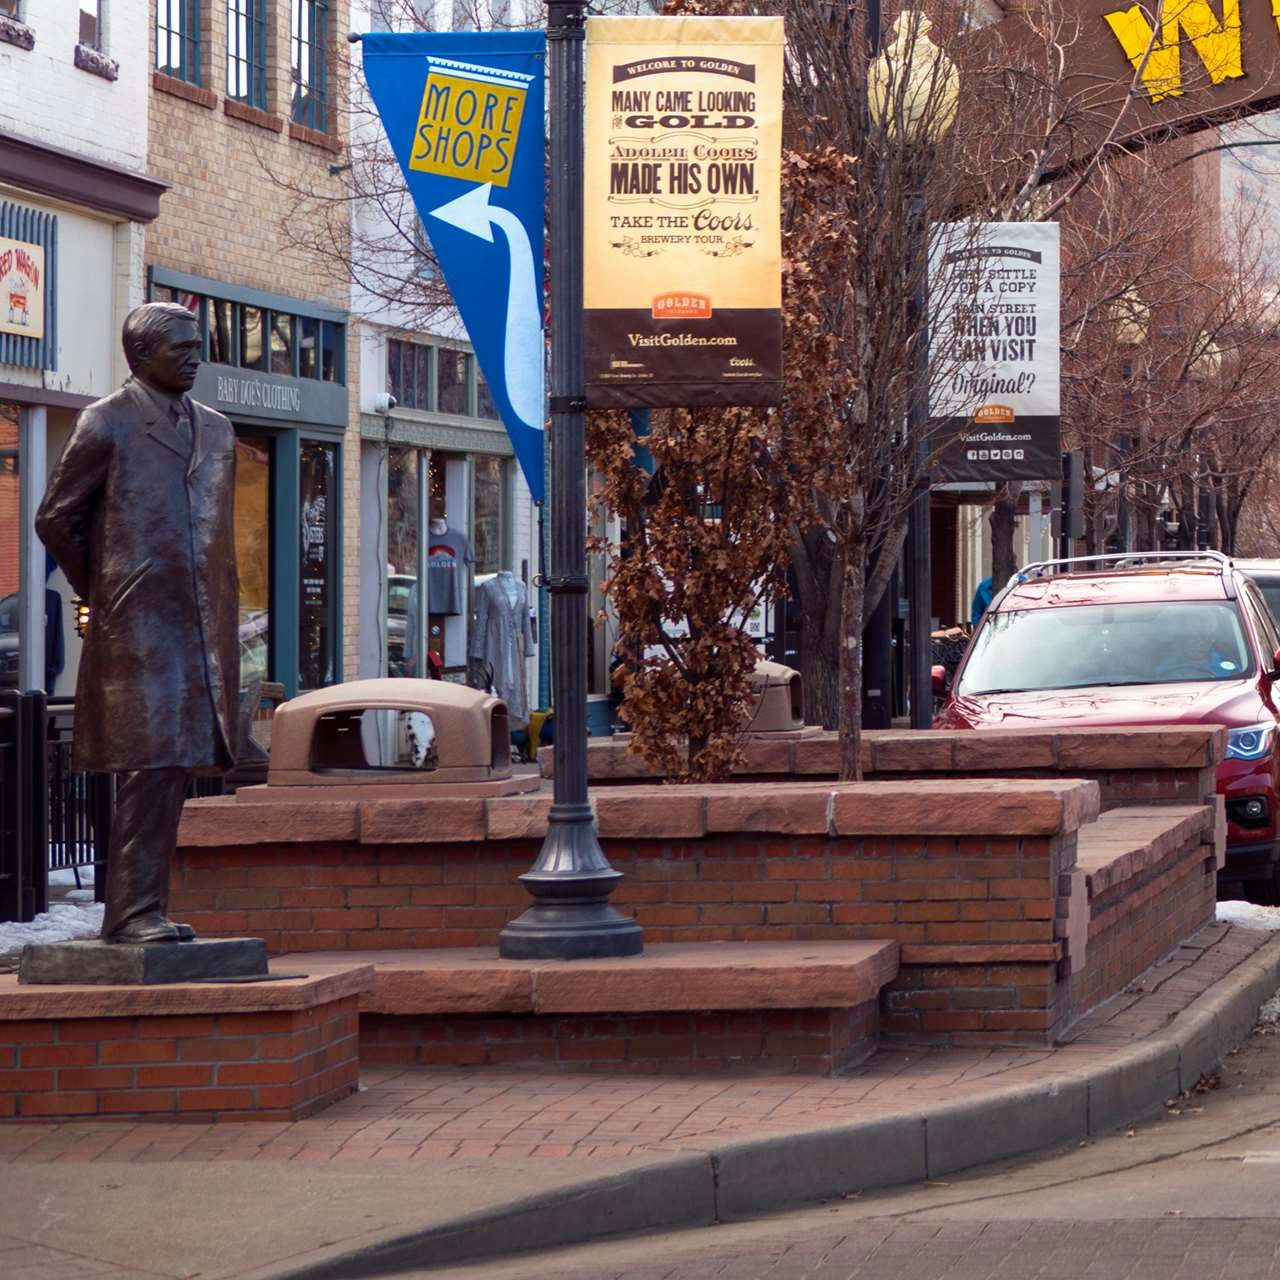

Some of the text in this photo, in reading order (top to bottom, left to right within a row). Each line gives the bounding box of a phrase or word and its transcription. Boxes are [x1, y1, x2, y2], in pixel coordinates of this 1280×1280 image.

[627, 59, 741, 74] WELCOME TO GOLDEN
[424, 84, 519, 134] MORE
[612, 91, 756, 112] MANY CAME LOOKING
[625, 115, 758, 129] GOLD.
[415, 124, 511, 173] SHOPS
[610, 163, 759, 194] MADE HIS OWN.
[610, 208, 753, 231] TAKE THE Coors
[640, 235, 692, 244] BREWERY
[1004, 249, 1032, 258] GOLDEN
[15, 248, 39, 291] WAGON
[988, 269, 1036, 279] SETTLE
[983, 283, 994, 292] A
[999, 282, 1036, 292] COPY
[657, 296, 707, 310] GOLDEN
[989, 304, 1036, 314] STREET
[952, 316, 1036, 336] WHEN YOU
[628, 333, 738, 347] VisitGolden.com
[990, 338, 1036, 361] VISIT
[952, 371, 1036, 400] Original?
[217, 376, 239, 403] BABY
[262, 384, 300, 412] CLOTHING
[978, 407, 1010, 417] GOLDEN
[960, 432, 1032, 441] VisitGolden.com
